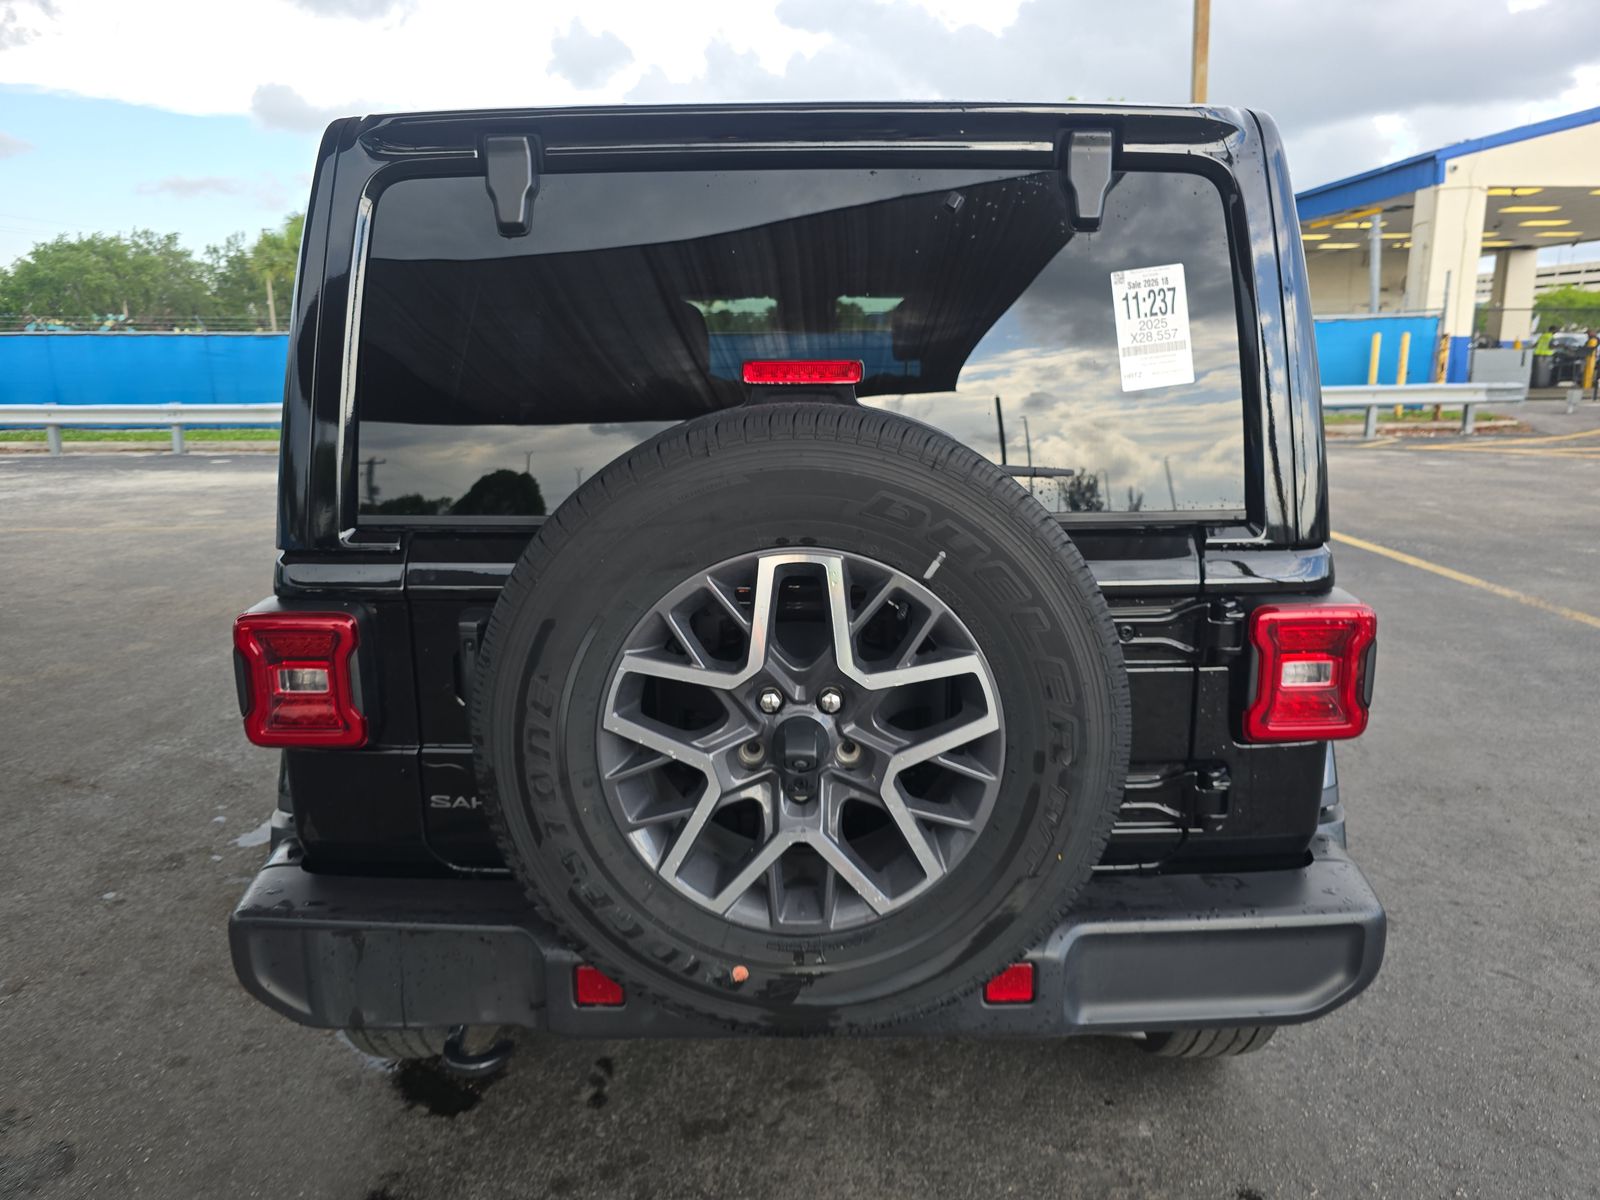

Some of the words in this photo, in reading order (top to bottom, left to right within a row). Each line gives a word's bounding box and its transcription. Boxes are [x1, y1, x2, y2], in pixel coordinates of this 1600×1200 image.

[1127, 280, 1141, 290] Sale
[1122, 286, 1176, 320] 11:237
[1138, 317, 1168, 331] 2025
[1130, 328, 1178, 344] X28.557
[858, 489, 1080, 767] DUELER
